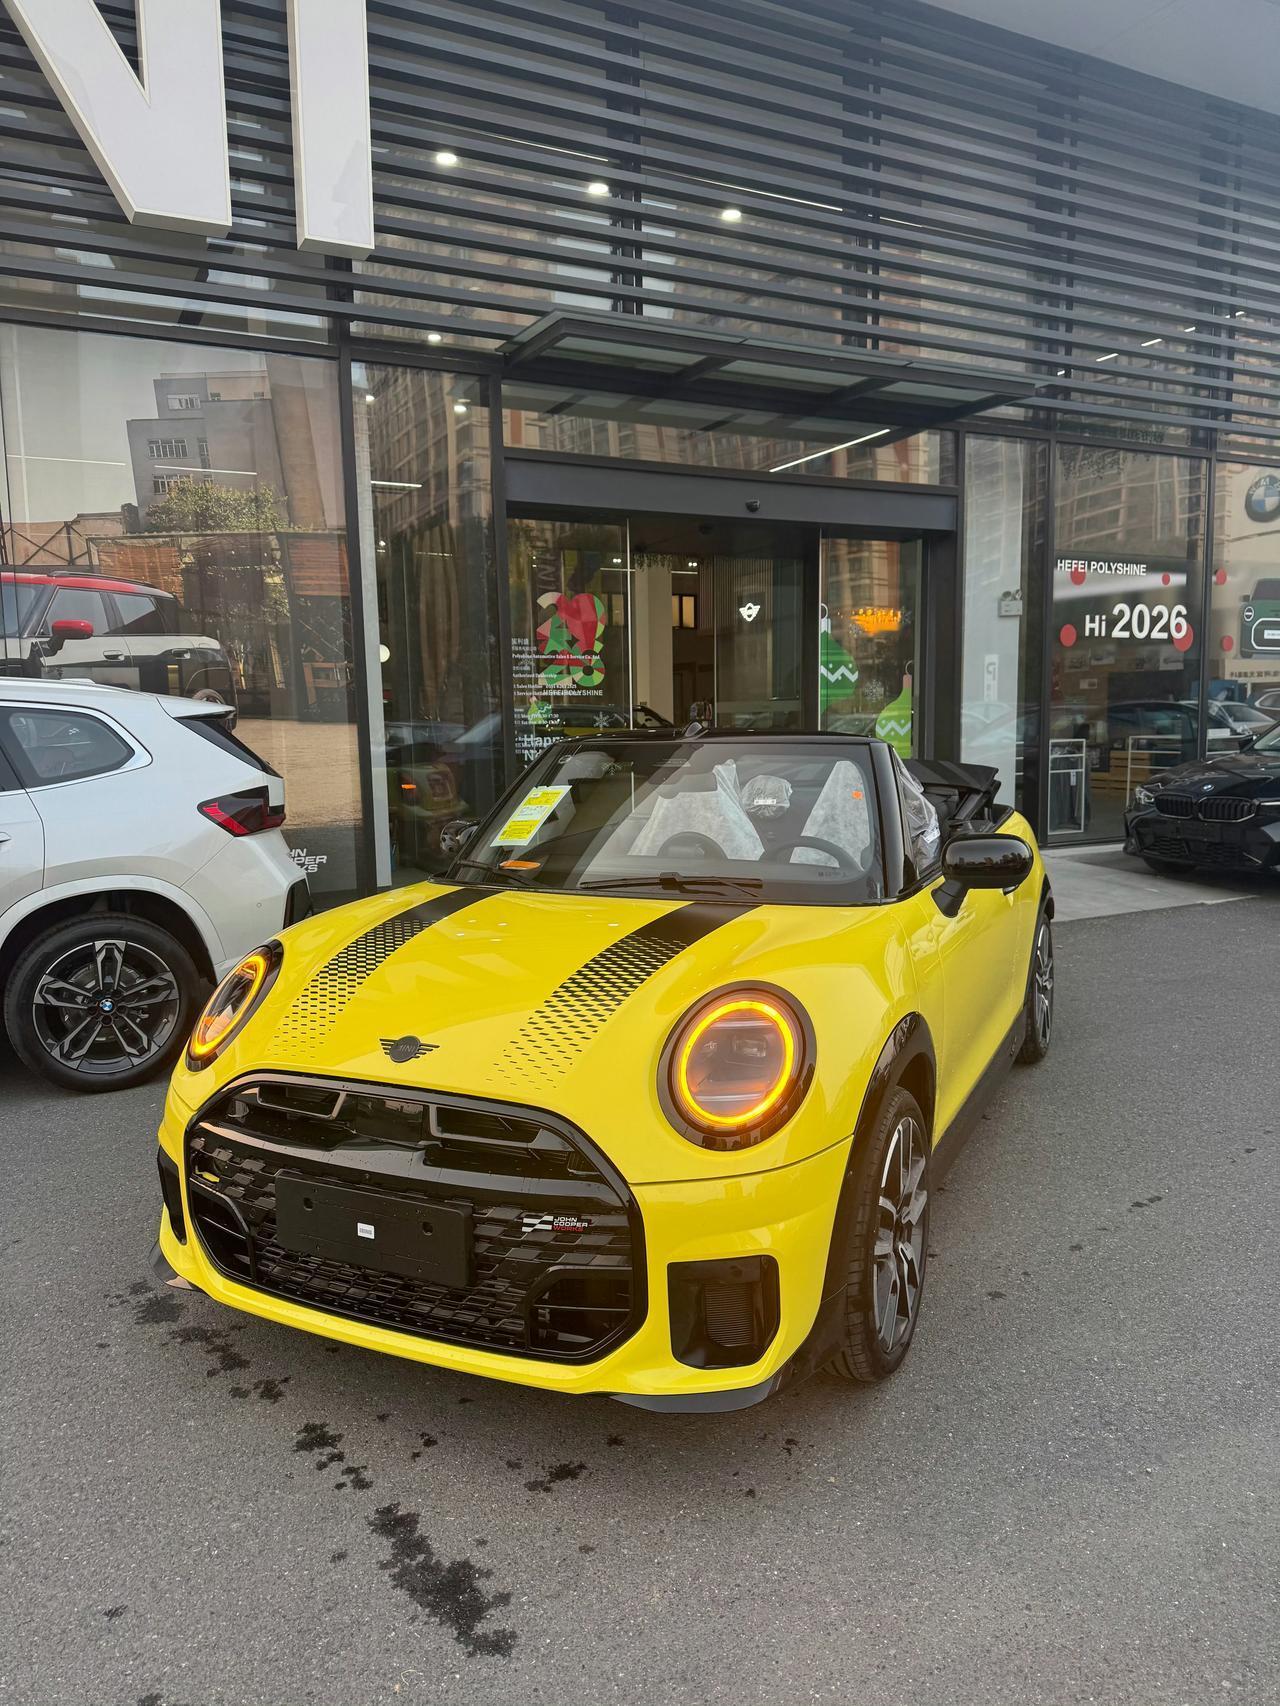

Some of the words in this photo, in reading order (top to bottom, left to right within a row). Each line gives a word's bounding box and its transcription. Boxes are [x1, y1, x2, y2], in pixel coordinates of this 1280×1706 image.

[1057, 559, 1088, 573] HEFEI
[1090, 561, 1147, 576] POLYSHINE
[1084, 614, 1107, 637] Hi
[1111, 603, 1188, 640] 2026
[292, 855, 327, 864] PER
